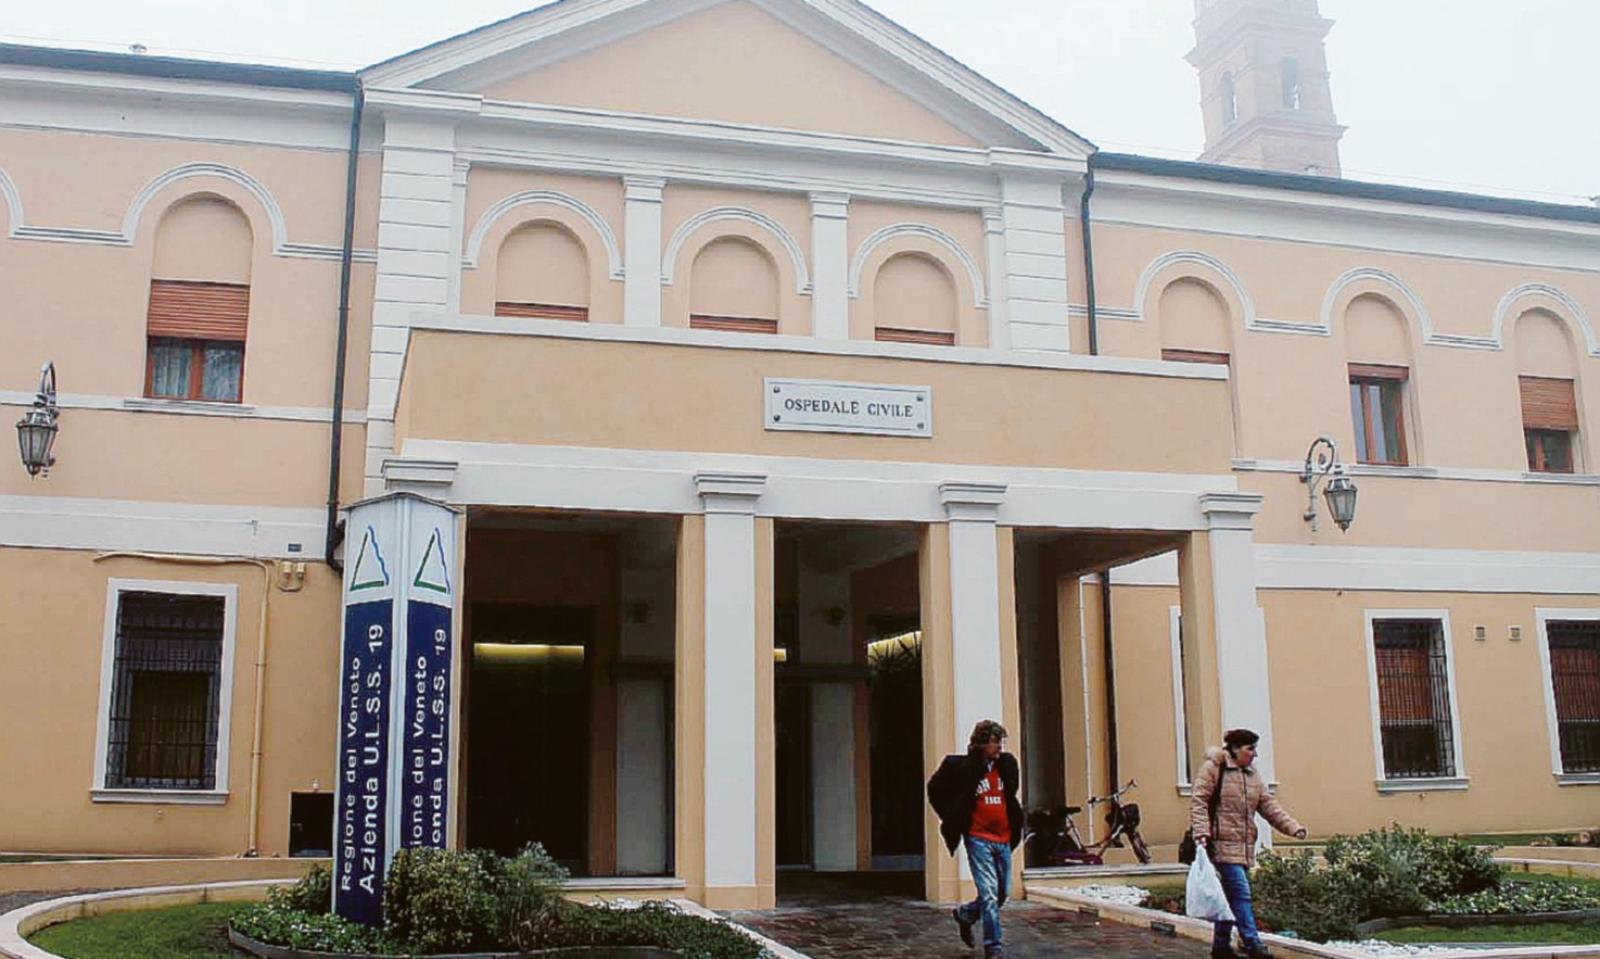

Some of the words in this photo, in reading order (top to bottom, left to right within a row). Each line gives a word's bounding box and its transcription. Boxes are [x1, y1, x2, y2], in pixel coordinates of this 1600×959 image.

[784, 398, 860, 415] OSPEDALE
[867, 403, 913, 418] CIVILE
[368, 624, 383, 653] 19
[435, 629, 446, 656] 19
[347, 657, 361, 738] Veneto
[363, 664, 382, 765] U.L.S.S.
[413, 656, 427, 738] Veneto
[431, 668, 446, 766] U.L.S.S.
[345, 748, 357, 783] del
[412, 748, 425, 784] del
[341, 794, 356, 891] Regione
[360, 777, 379, 894] Azienda
[410, 794, 424, 846] ione
[430, 777, 443, 850] ienda
